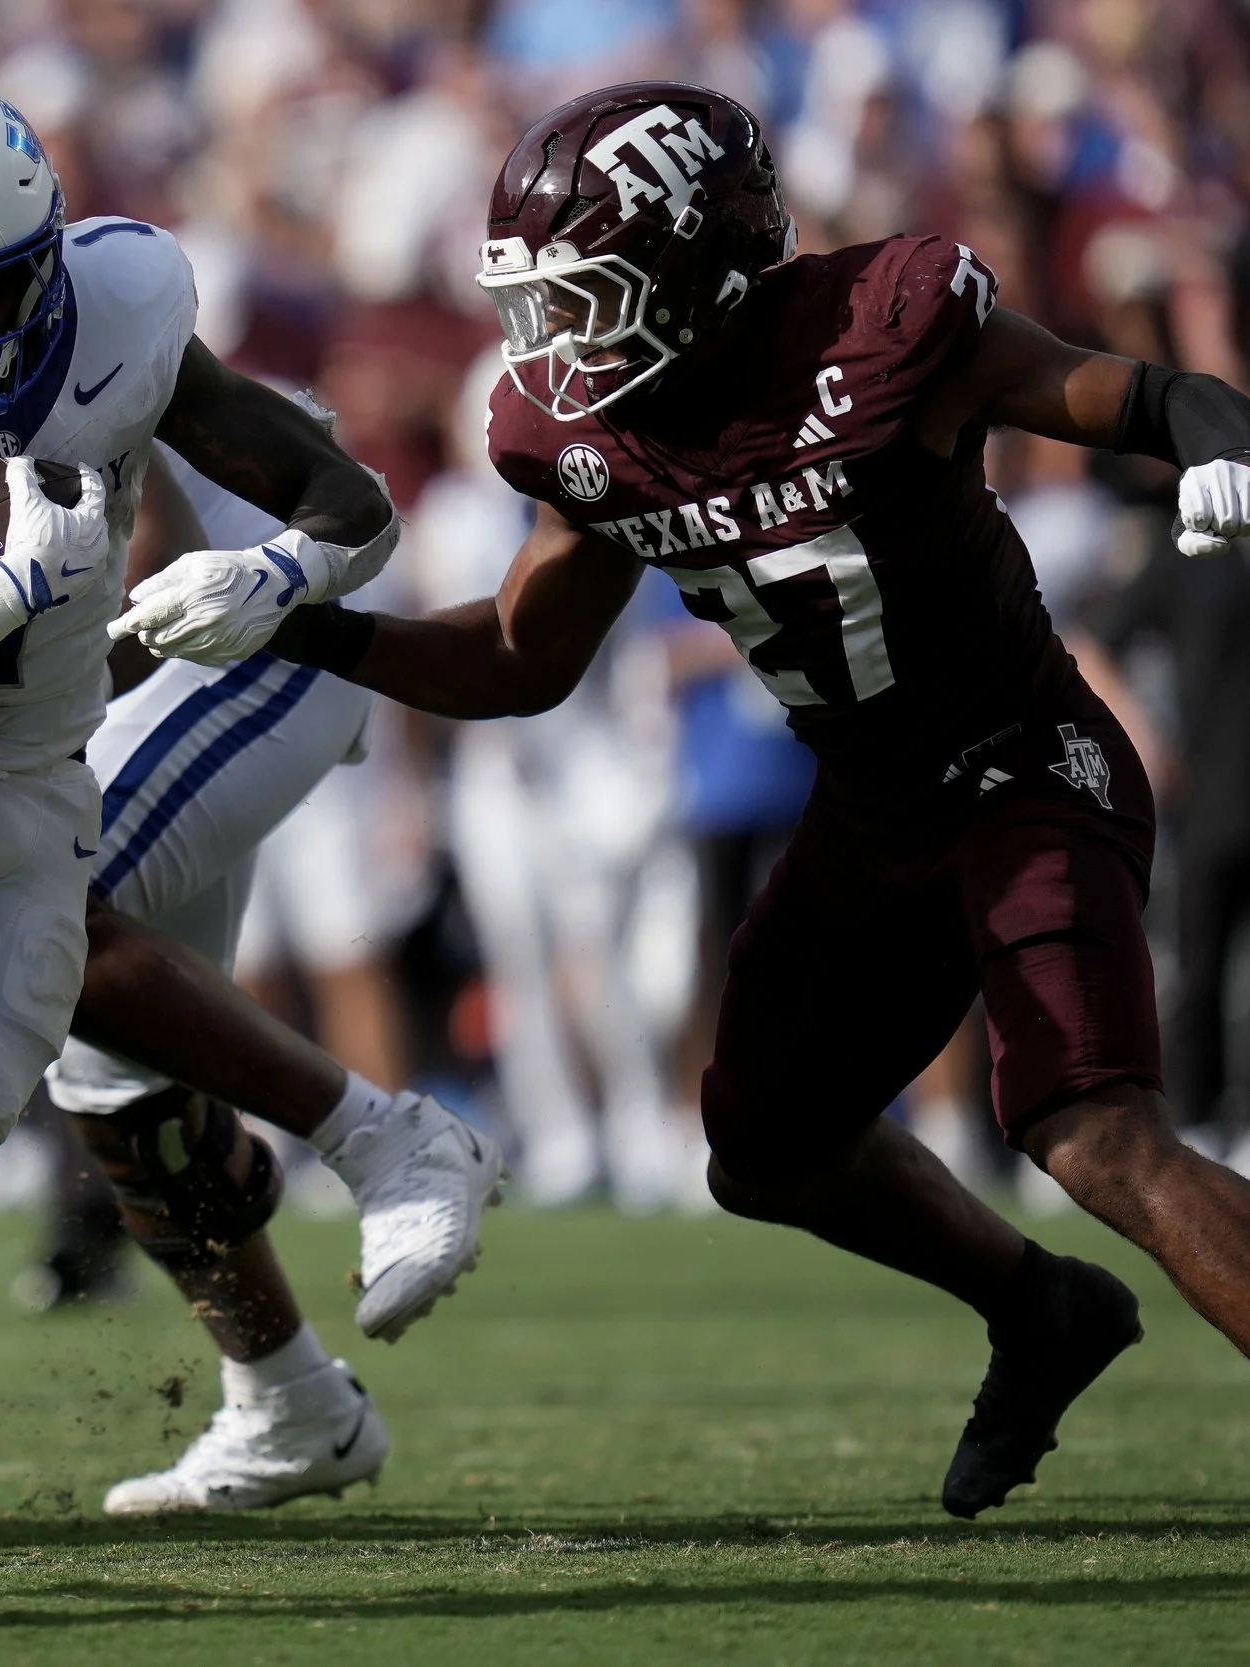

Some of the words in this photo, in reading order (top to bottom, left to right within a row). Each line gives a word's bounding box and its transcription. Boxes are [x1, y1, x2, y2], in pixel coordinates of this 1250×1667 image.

[815, 365, 853, 418] C
[561, 448, 606, 498] SEC
[588, 495, 742, 559] TEXAS
[750, 459, 855, 532] A&M
[661, 524, 896, 706] 27
